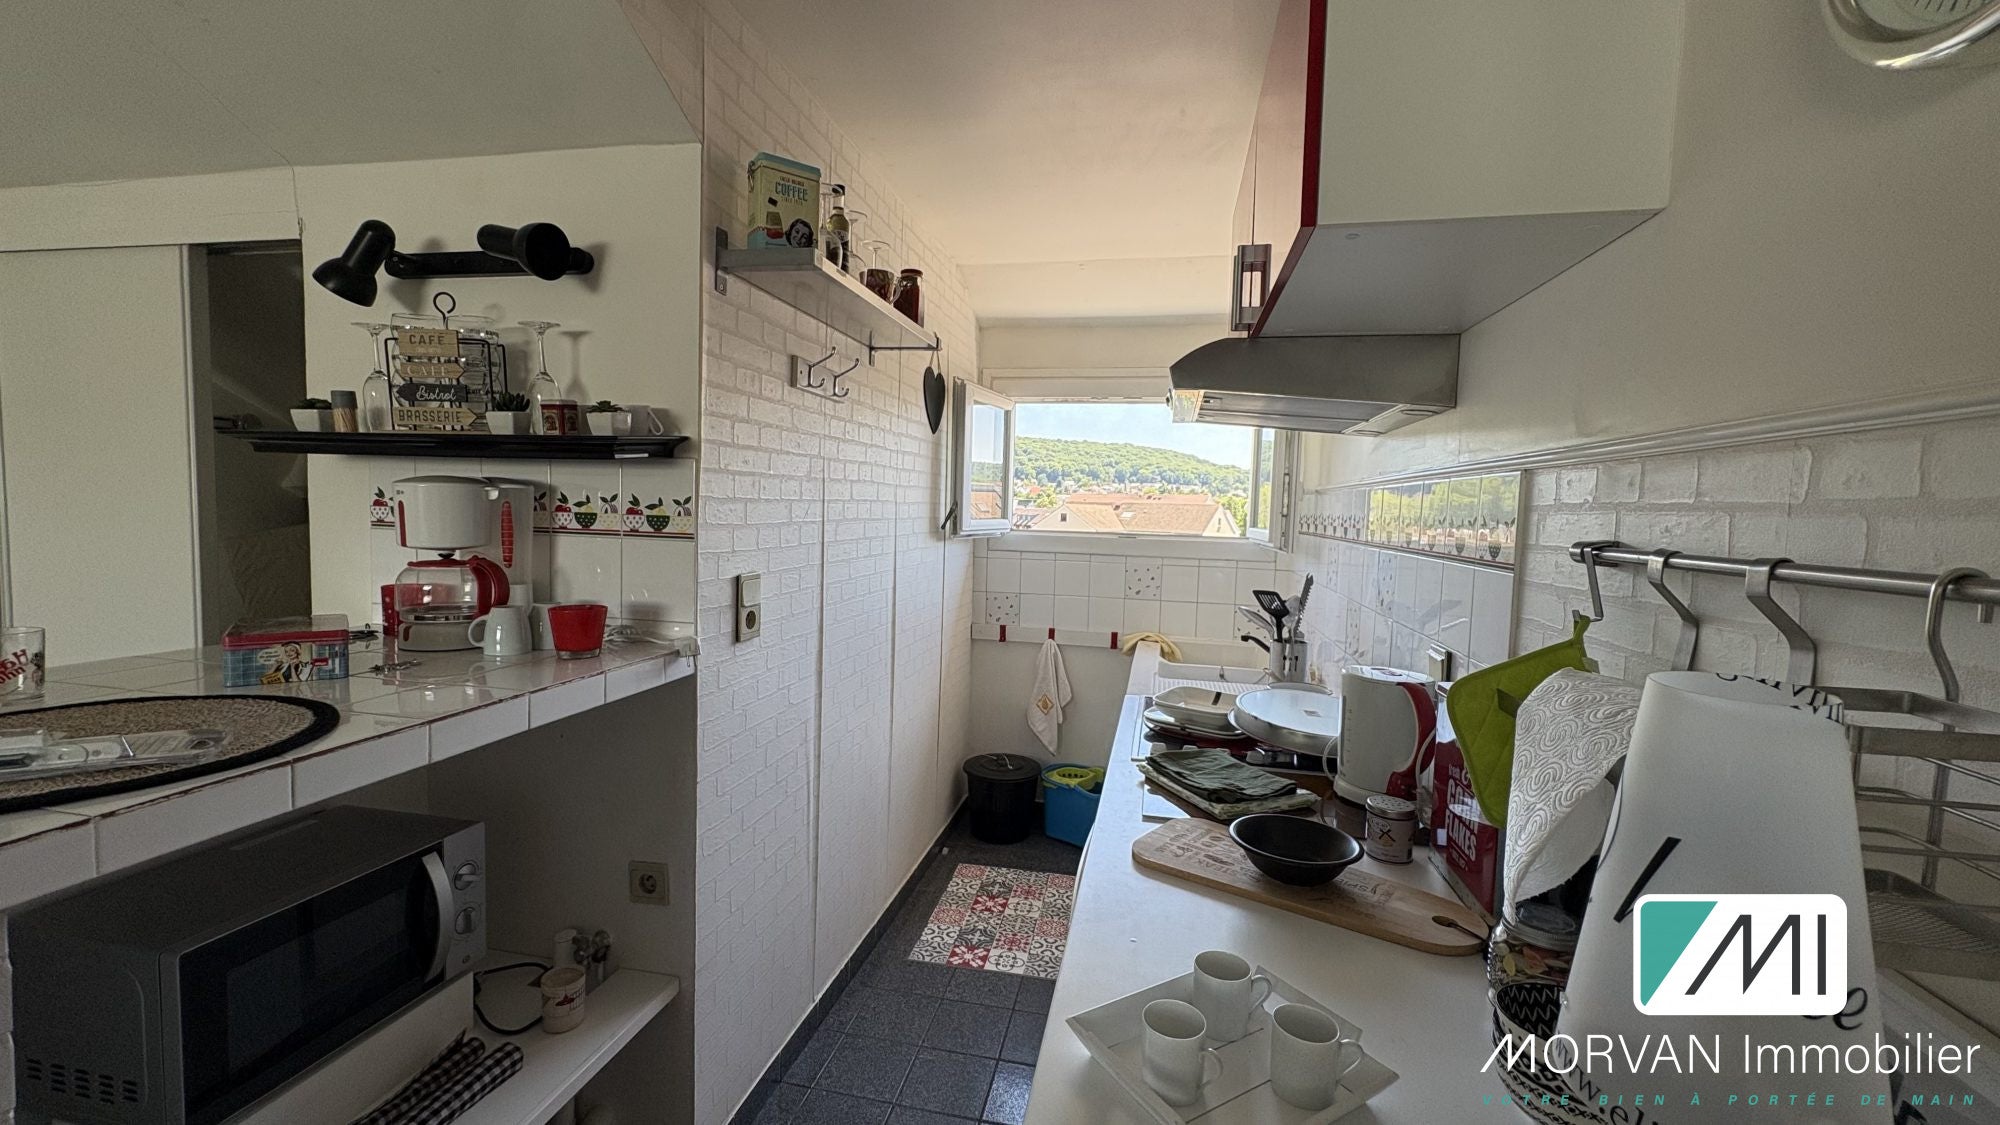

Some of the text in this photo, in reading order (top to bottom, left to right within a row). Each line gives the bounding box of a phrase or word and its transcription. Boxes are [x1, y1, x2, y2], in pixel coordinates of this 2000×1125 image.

[775, 181, 808, 202] COFFEE
[416, 385, 457, 400] Bistrot
[399, 409, 463, 423] BRASSERIE
[1445, 808, 1478, 861] FLAKES
